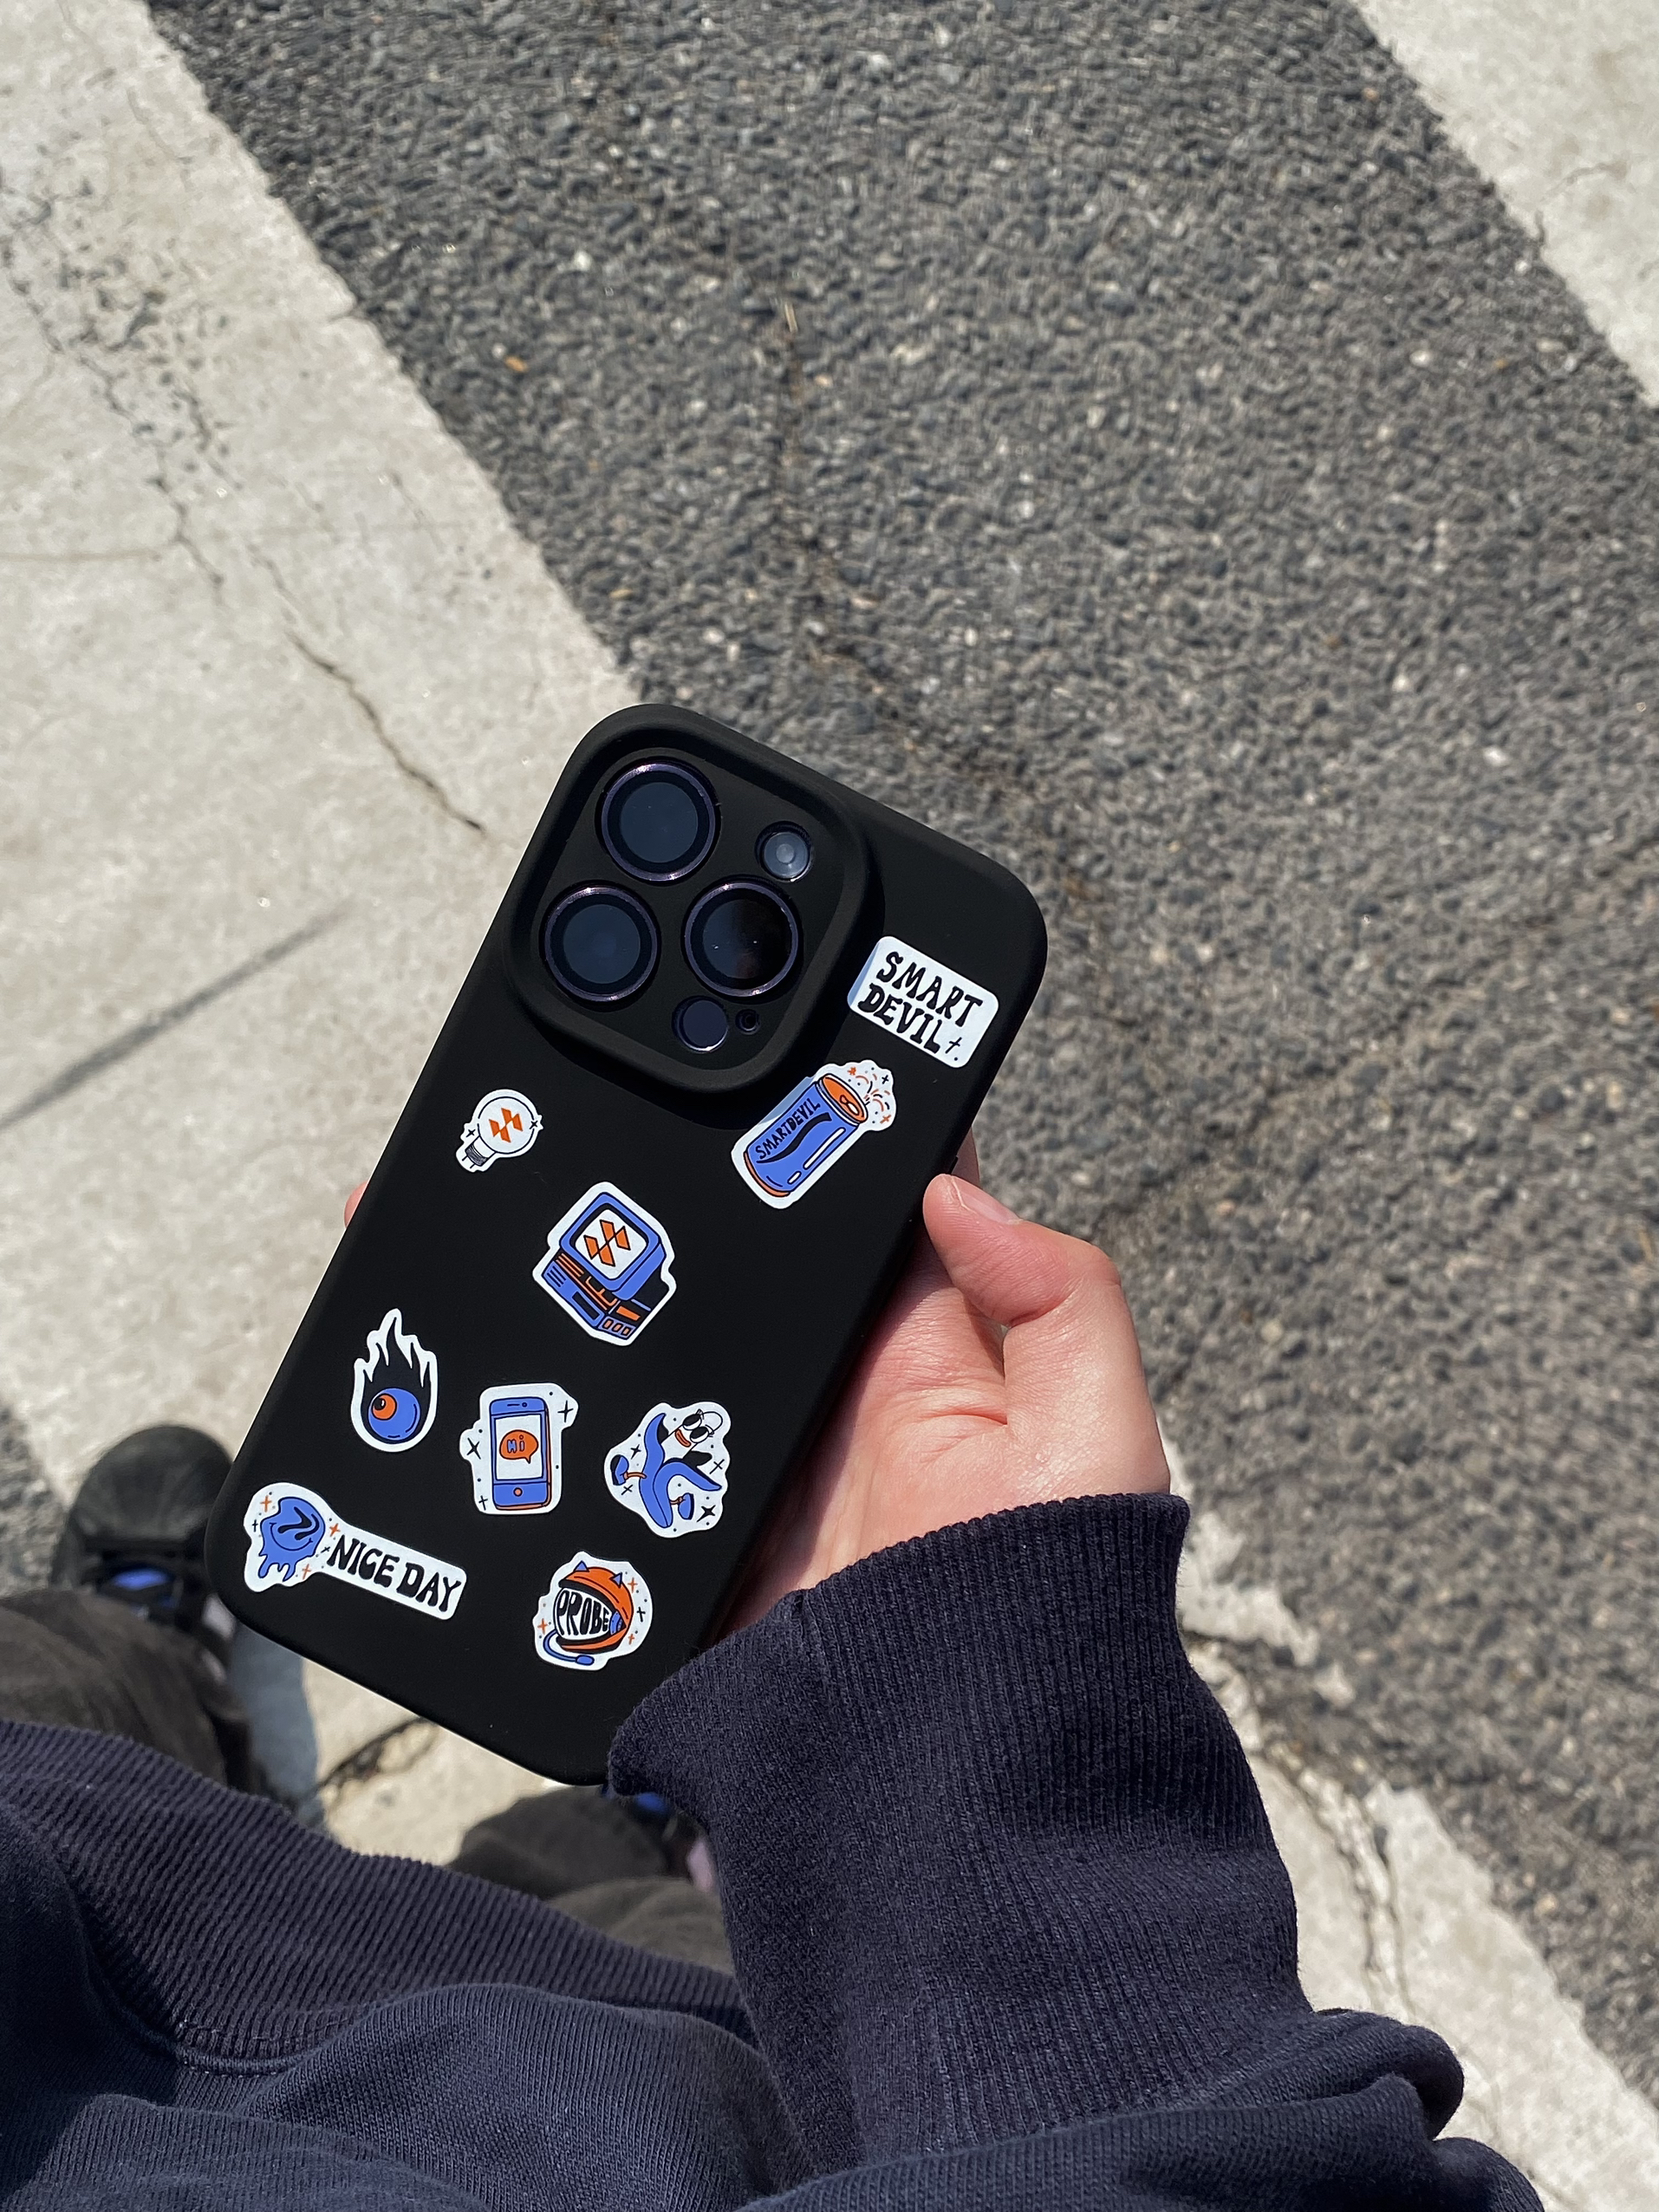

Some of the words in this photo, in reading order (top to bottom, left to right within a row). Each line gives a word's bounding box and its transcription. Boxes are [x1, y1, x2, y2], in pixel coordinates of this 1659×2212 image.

[857, 982, 943, 1054] DEVIL
[875, 951, 983, 1027] SMART
[755, 1097, 821, 1160] SMARTDEVIL
[327, 1534, 400, 1588] NICE
[396, 1562, 461, 1612] DAY
[556, 1590, 609, 1636] PROBE
